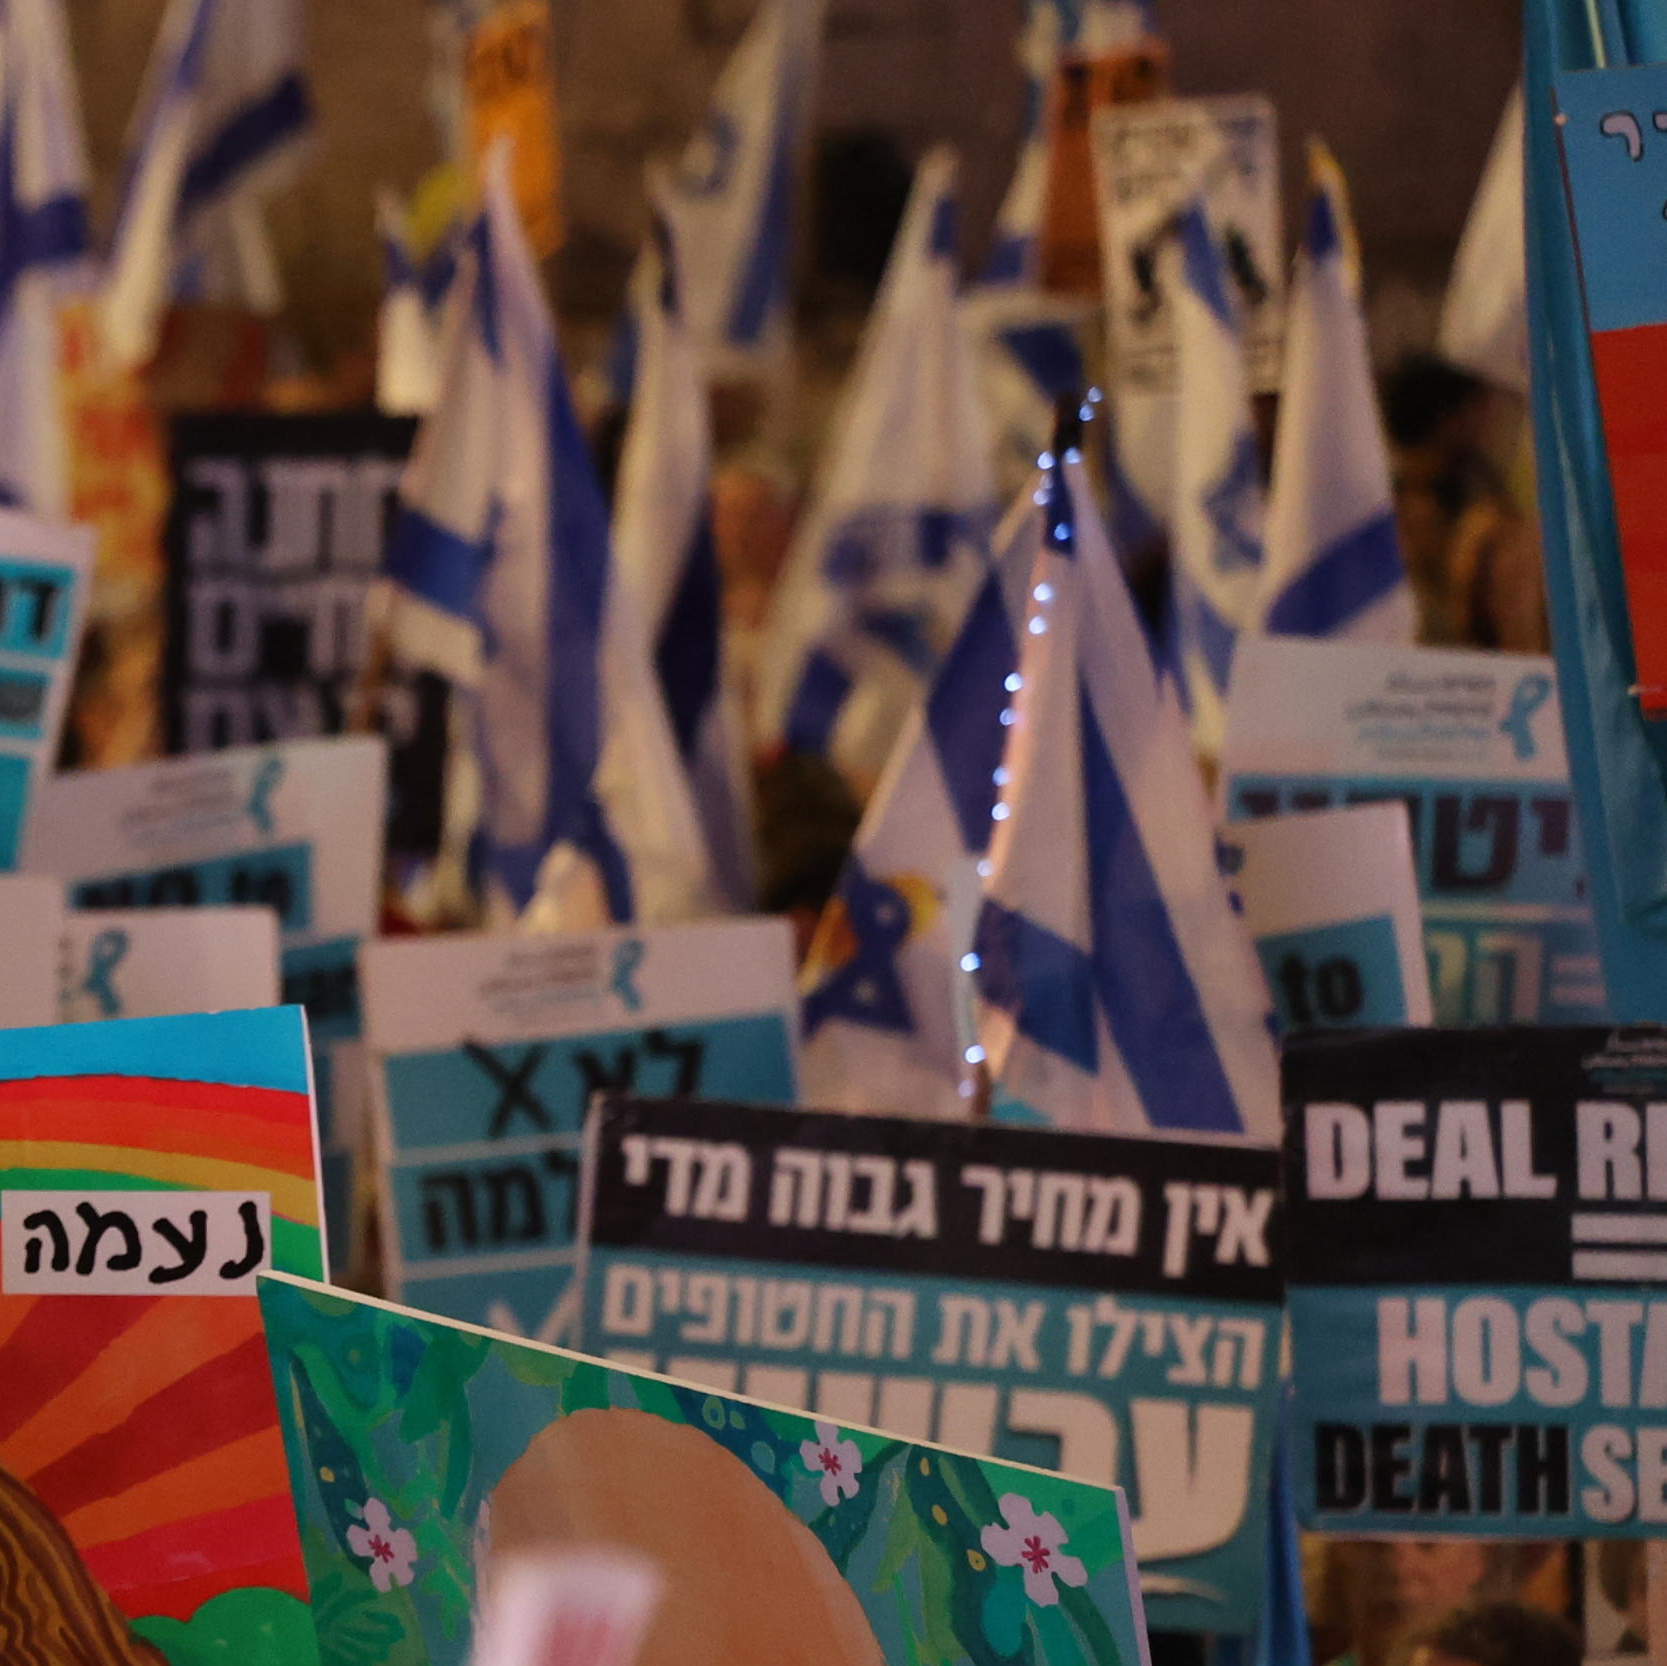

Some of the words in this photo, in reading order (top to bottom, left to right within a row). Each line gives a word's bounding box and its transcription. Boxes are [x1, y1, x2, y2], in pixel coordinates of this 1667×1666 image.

[620, 1133, 754, 1221] מדי
[768, 1147, 940, 1240] גבוה
[1304, 1101, 1557, 1200] DEAL
[23, 1200, 265, 1284] נעמה
[960, 1164, 1142, 1257] מחיר
[1163, 1181, 1271, 1278] אין
[601, 1262, 915, 1360] החטופים
[932, 1296, 1047, 1372] את
[1065, 1294, 1265, 1391] הצילו
[1314, 1423, 1572, 1516] DEATH
